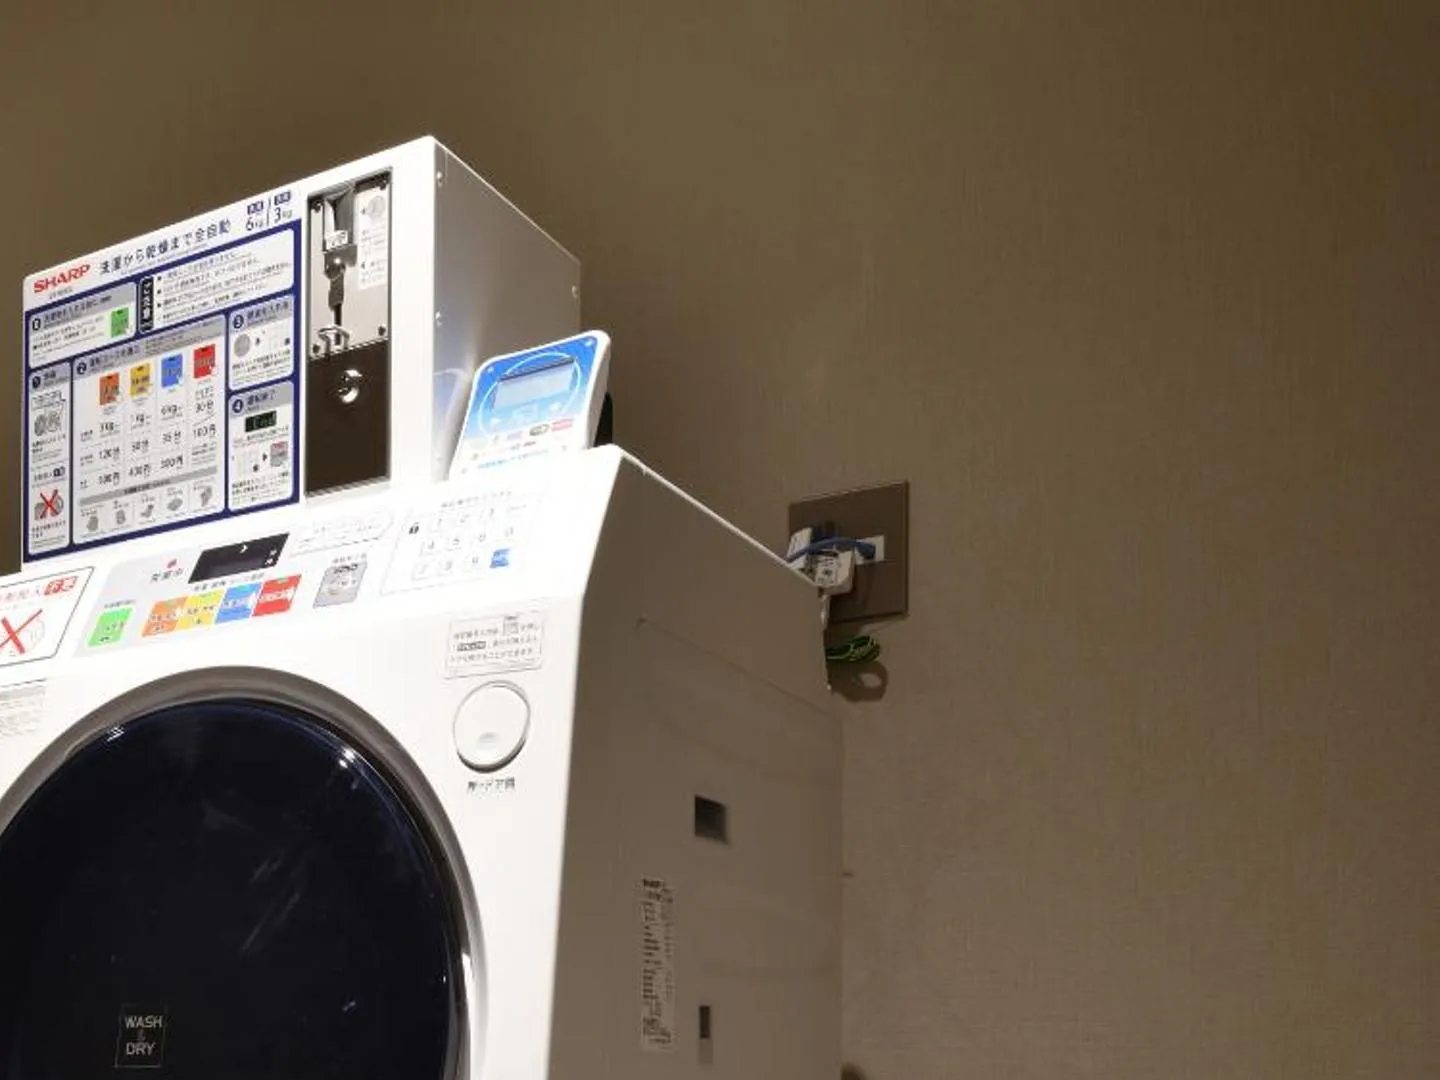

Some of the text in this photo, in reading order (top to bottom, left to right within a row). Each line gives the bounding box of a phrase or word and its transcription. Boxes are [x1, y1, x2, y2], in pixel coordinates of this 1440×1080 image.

[33, 263, 91, 293] SHARP
[124, 1015, 162, 1028] WASH
[126, 1042, 156, 1055] DRY
